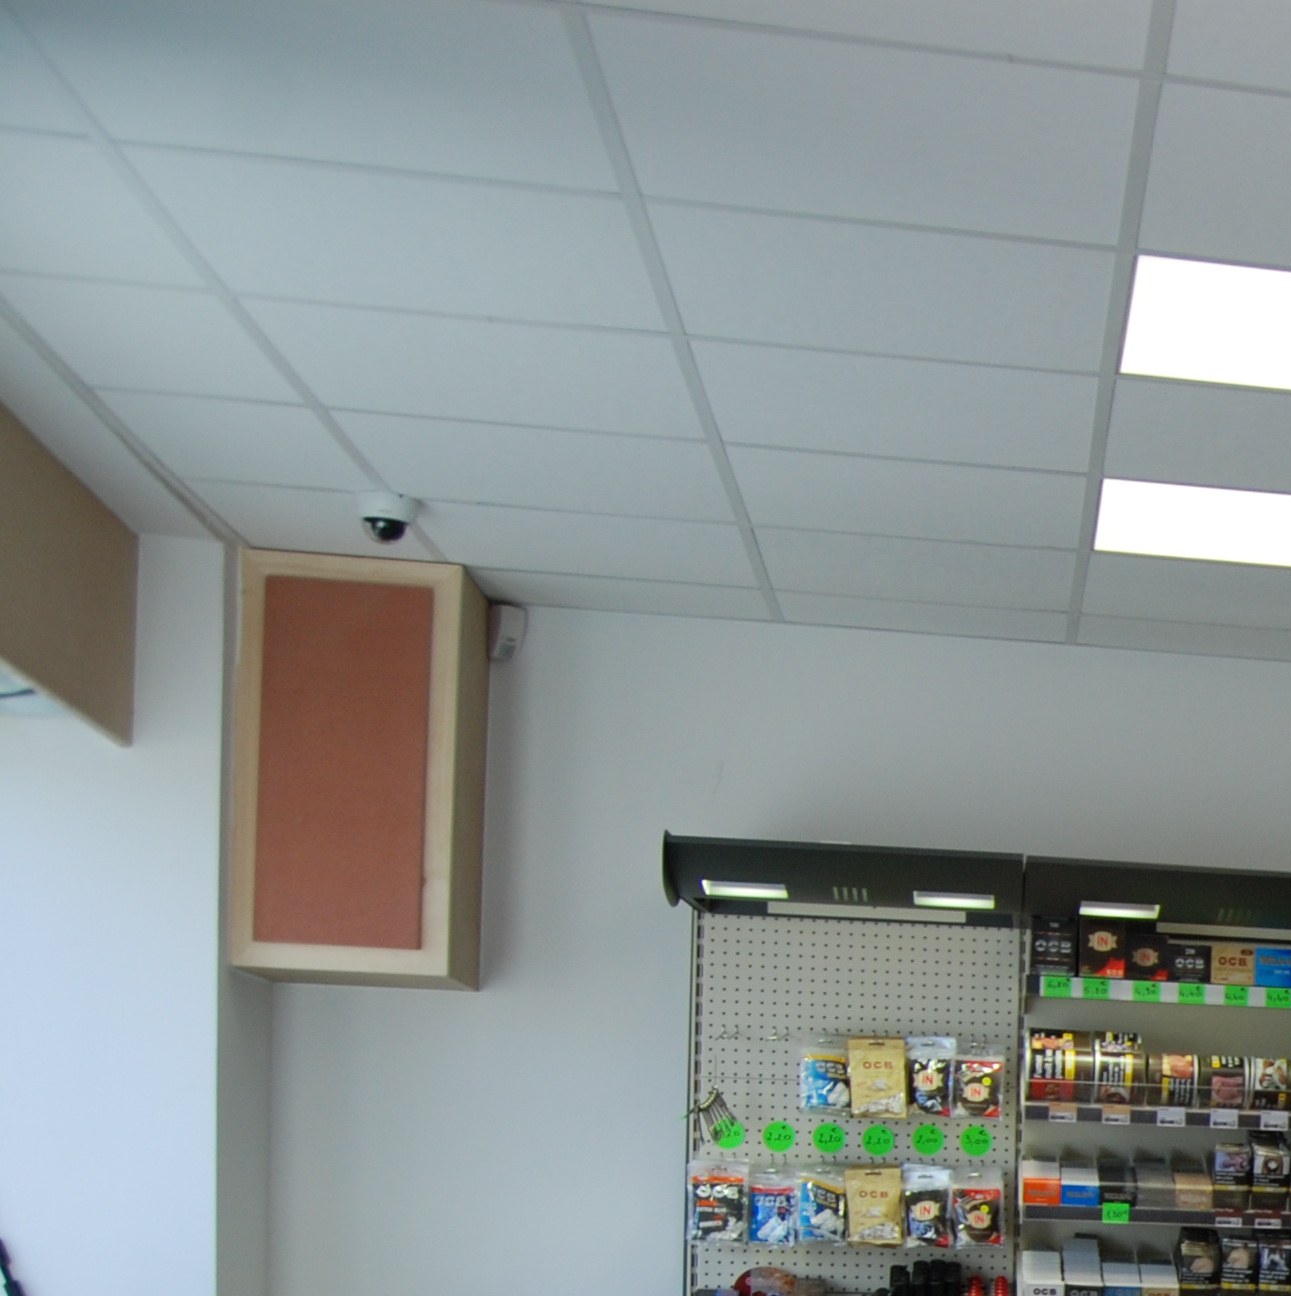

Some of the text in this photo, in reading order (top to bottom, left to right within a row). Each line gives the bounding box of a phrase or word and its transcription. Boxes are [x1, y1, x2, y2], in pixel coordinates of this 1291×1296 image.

[1218, 956, 1248, 967] OCB
[863, 1061, 893, 1069] OCB
[859, 1190, 889, 1199] OCB
[1033, 1287, 1057, 1296] OCB
